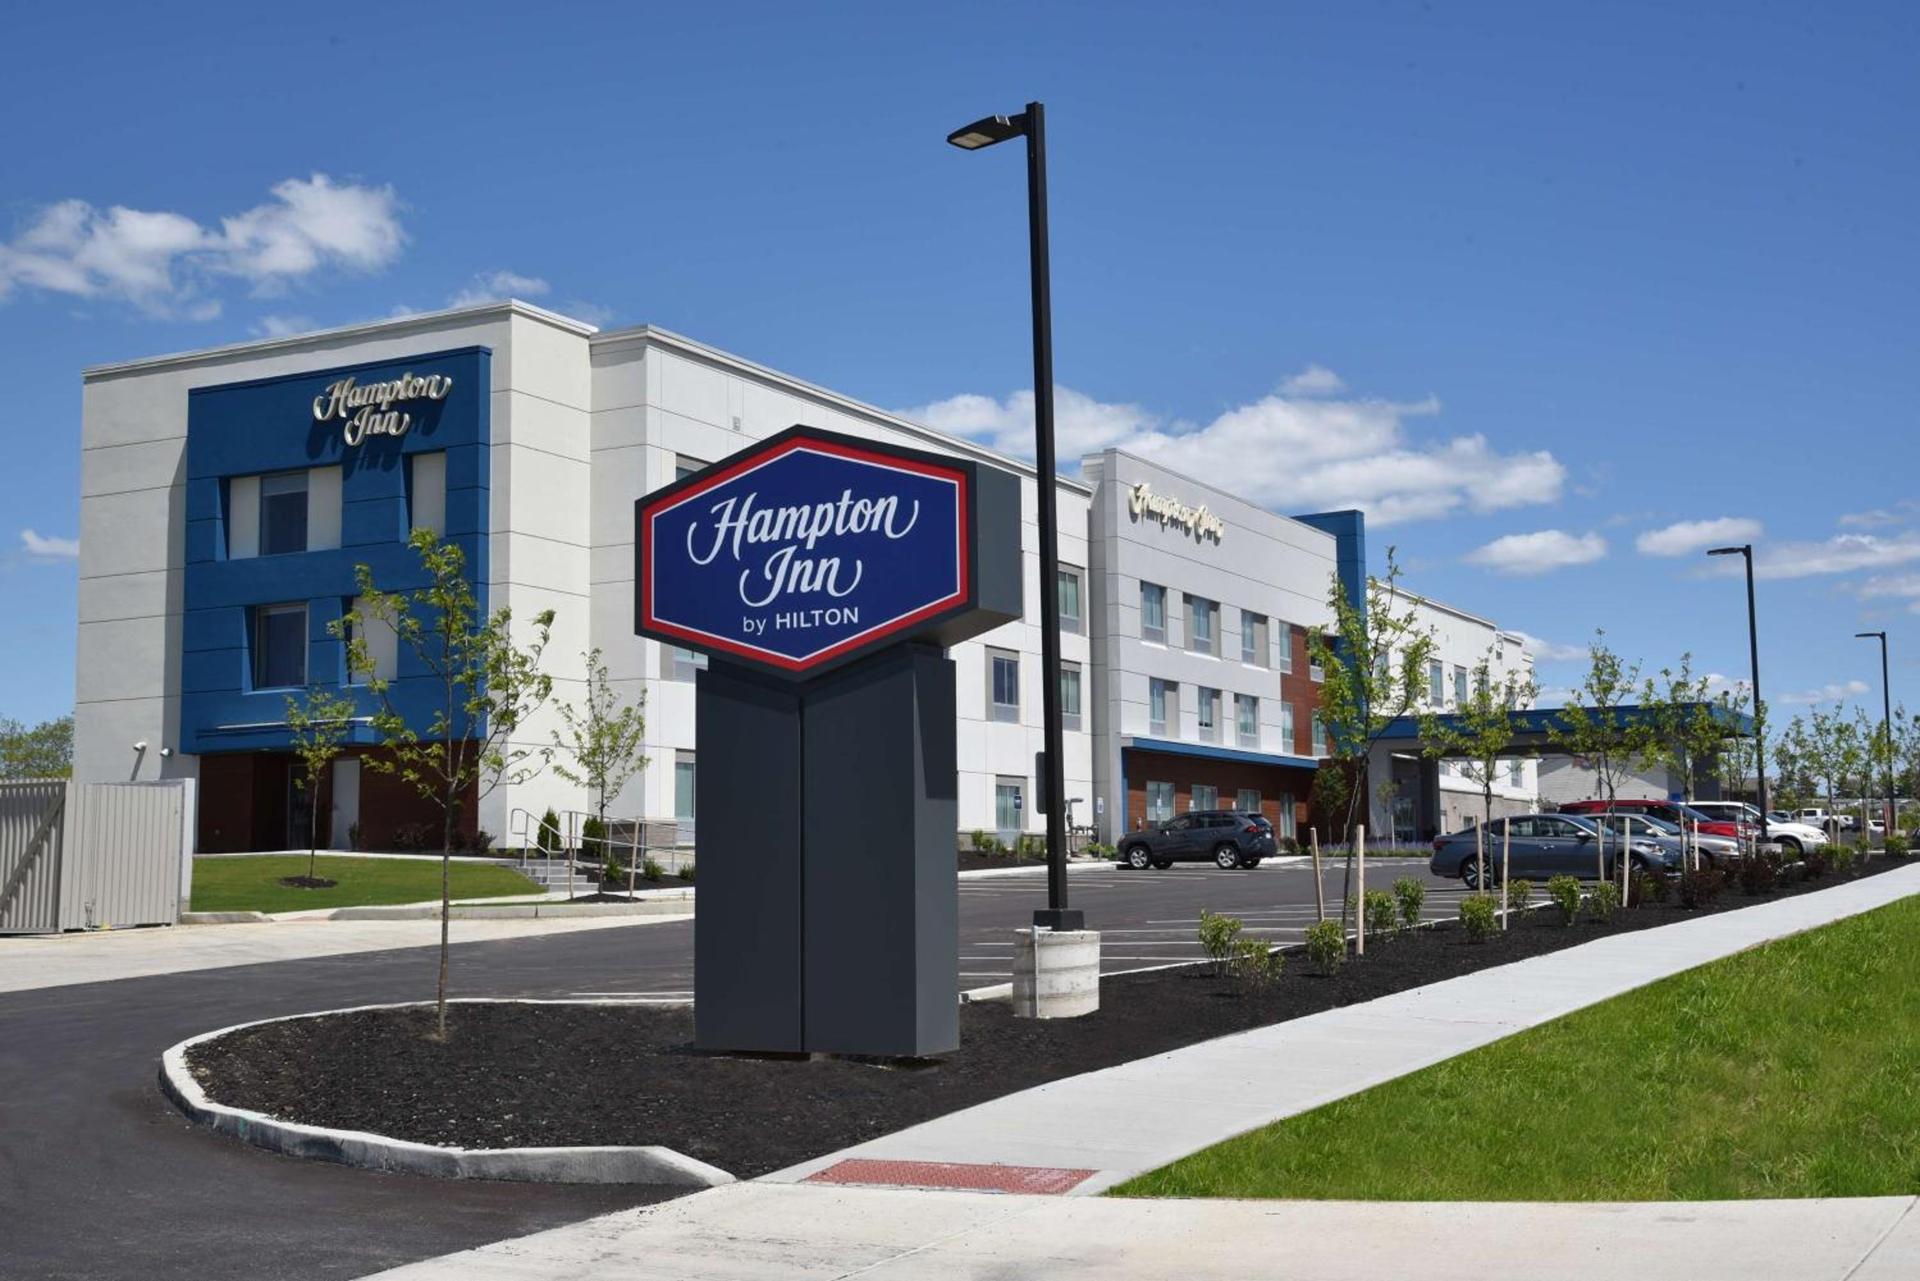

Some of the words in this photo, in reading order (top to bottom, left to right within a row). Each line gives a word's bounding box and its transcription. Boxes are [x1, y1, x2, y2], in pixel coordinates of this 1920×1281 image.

[313, 372, 453, 421] Hampton
[344, 405, 410, 446] Inn
[687, 488, 919, 565] Hampton
[739, 545, 862, 607] Inn
[743, 615, 767, 636] by
[775, 606, 859, 630] HILTON
